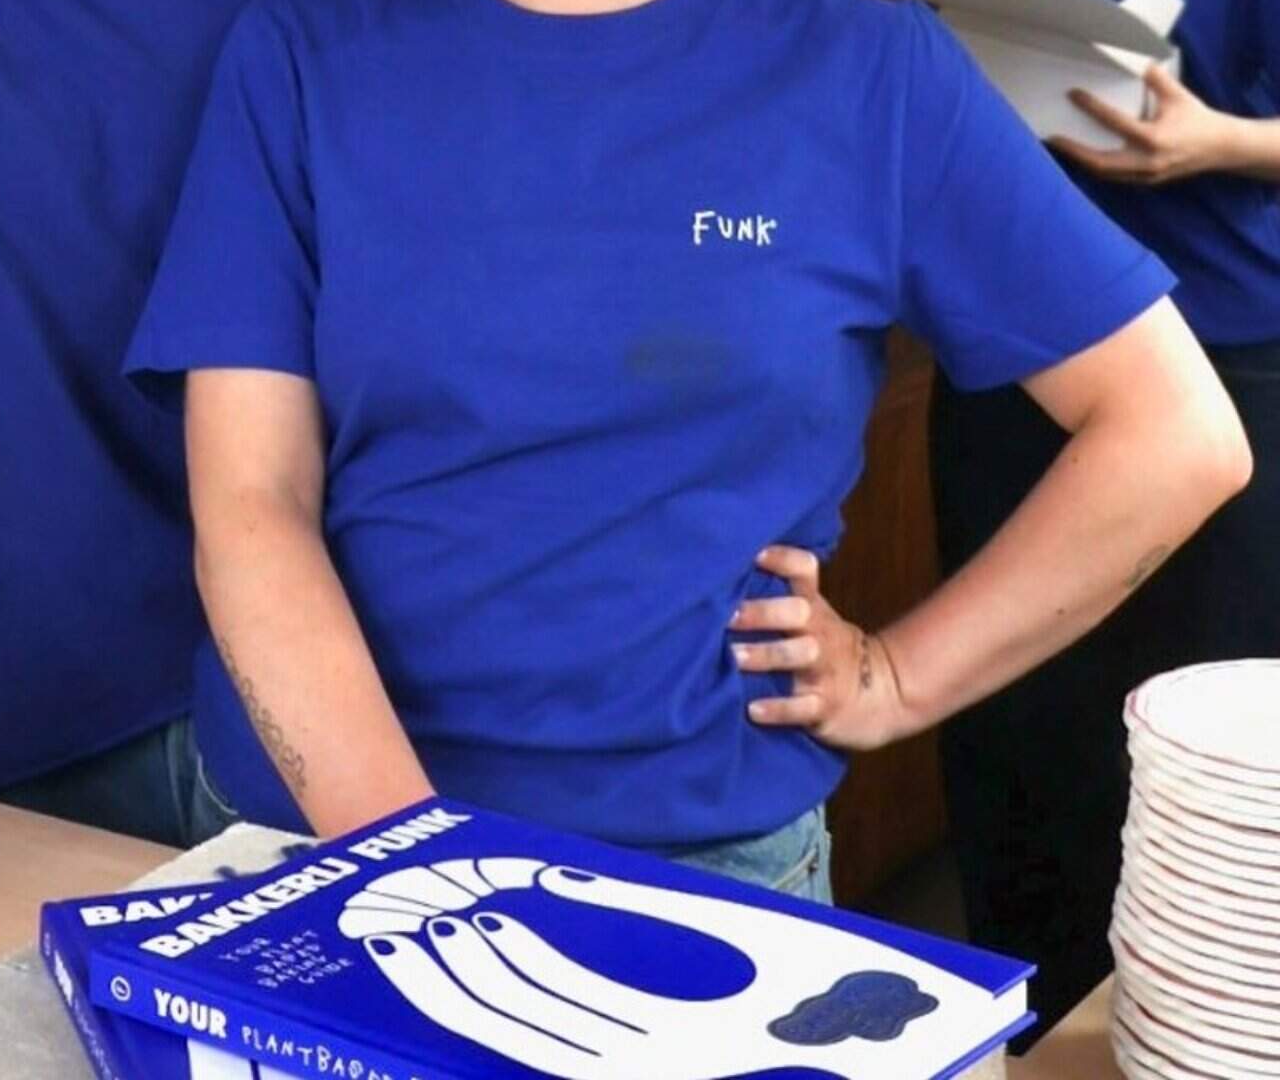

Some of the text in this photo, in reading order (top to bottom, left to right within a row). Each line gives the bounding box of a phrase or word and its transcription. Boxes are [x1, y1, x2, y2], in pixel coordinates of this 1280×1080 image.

[693, 210, 777, 246] FUNK
[347, 807, 472, 861] FUNK
[153, 988, 227, 1039] YOUR
